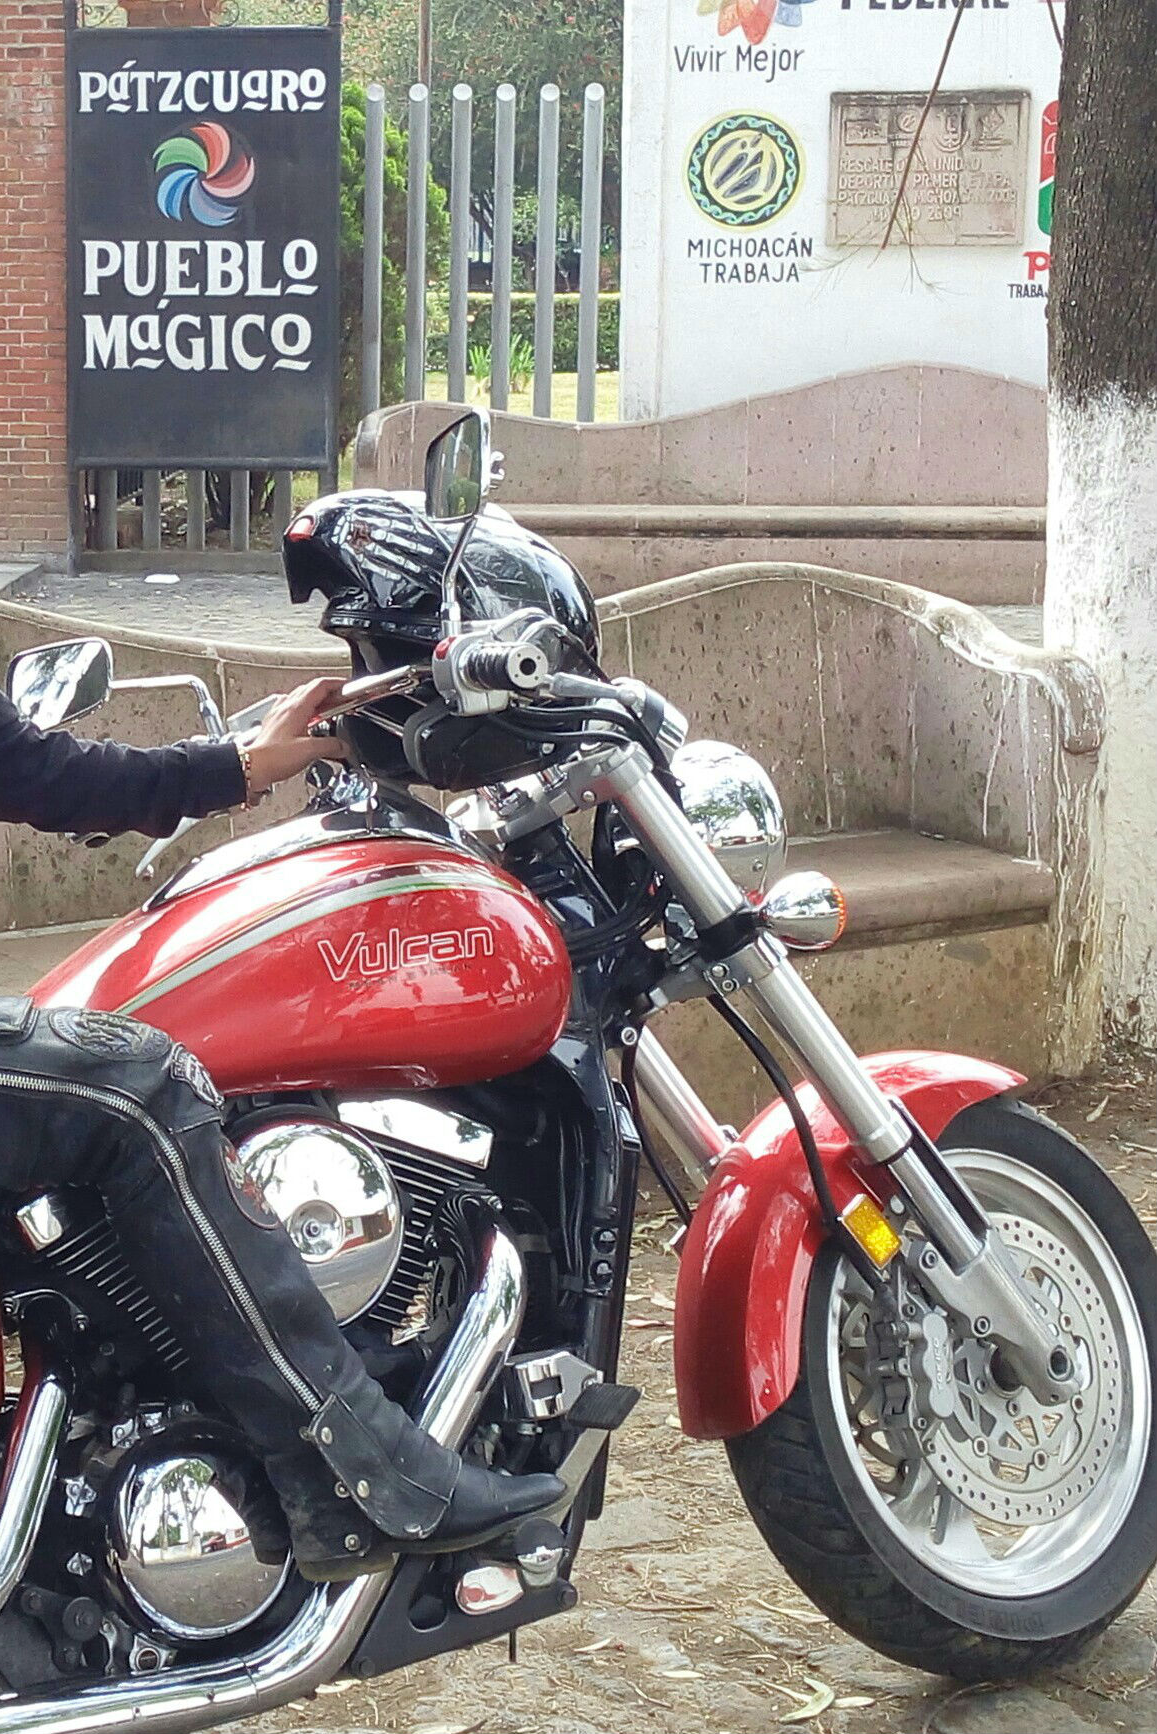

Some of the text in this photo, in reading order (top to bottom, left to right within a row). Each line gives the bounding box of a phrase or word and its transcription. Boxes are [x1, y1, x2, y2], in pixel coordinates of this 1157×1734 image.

[674, 44, 805, 83] Vivir Mejor
[933, 157, 983, 172] UNIDD
[687, 232, 813, 258] MICHOACÁN
[699, 262, 800, 283] TRABAJA
[317, 926, 494, 981] Vulcan
